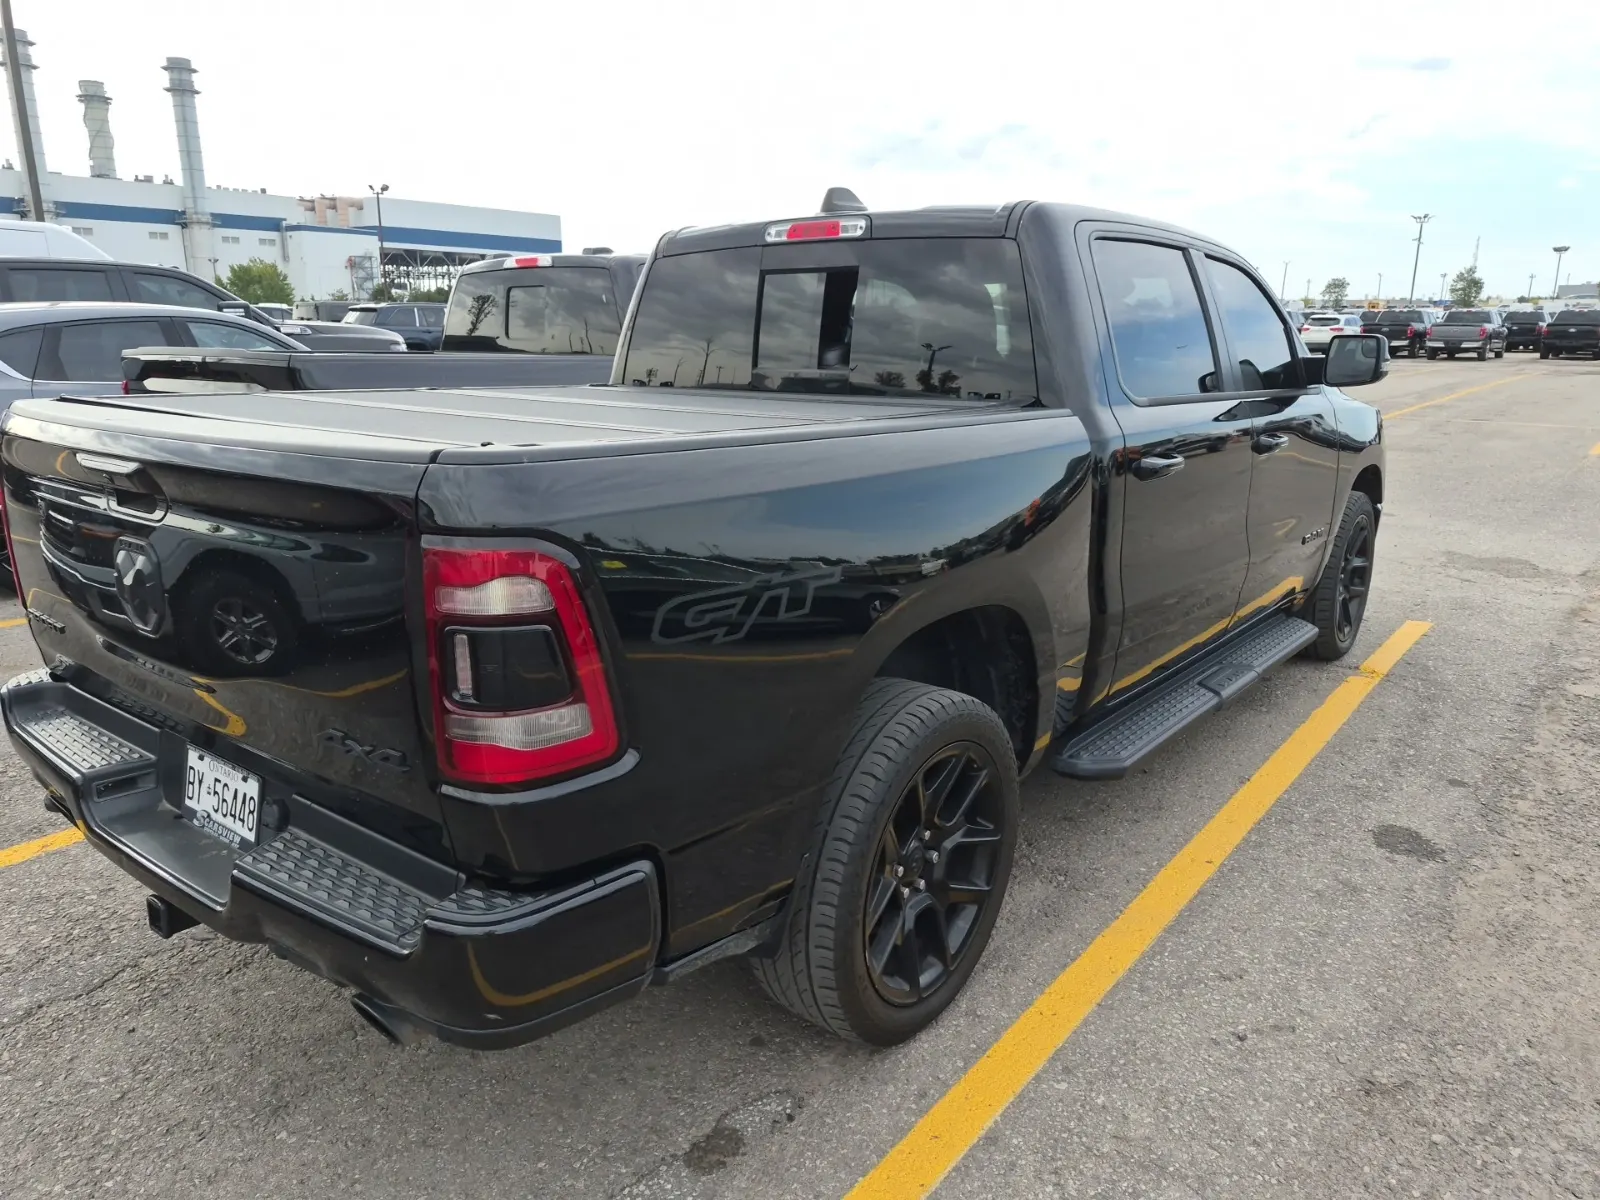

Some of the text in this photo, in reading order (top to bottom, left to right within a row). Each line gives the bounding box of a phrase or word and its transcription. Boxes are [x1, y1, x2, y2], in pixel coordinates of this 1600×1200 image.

[208, 759, 239, 782] ONTARIO
[186, 765, 257, 832] BY 56448
[192, 809, 242, 844] SCARSVIEW
